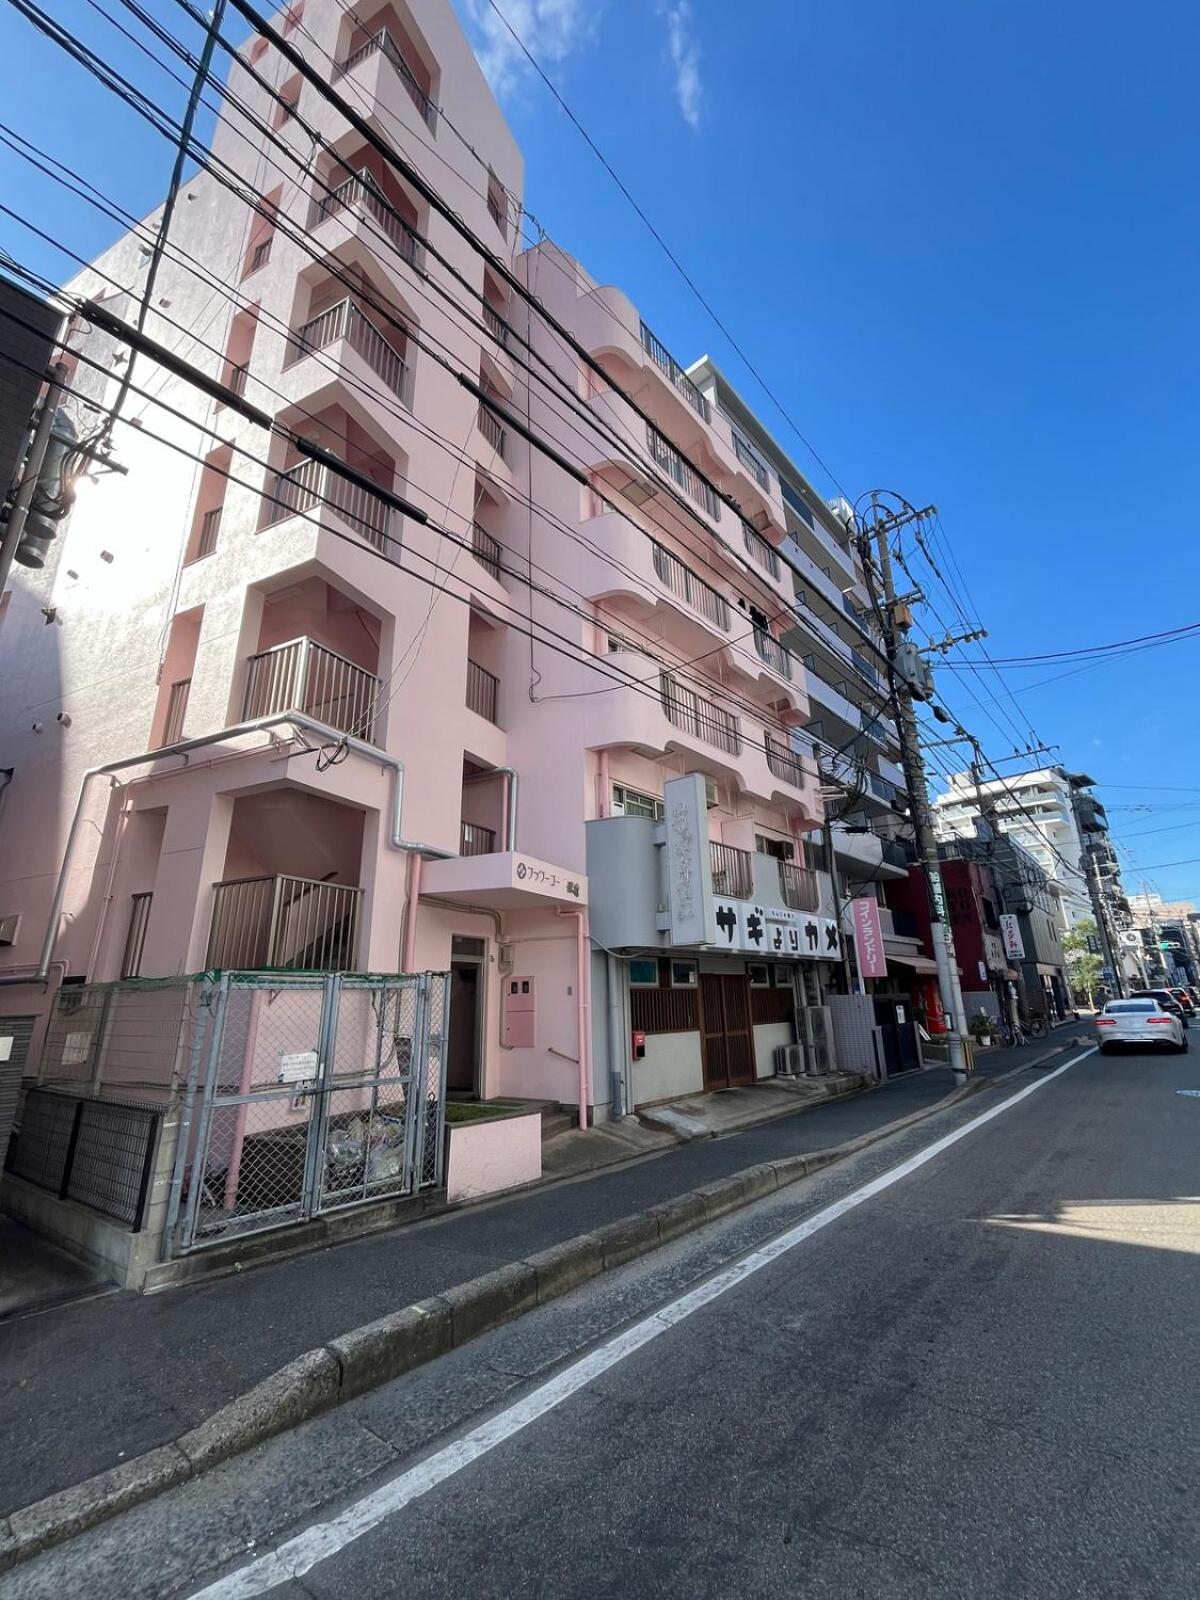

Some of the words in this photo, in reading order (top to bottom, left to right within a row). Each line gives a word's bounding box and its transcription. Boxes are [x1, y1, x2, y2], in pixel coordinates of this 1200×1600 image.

[716, 905, 838, 951] サギよりカメ
[859, 901, 877, 974] コインランドリー
